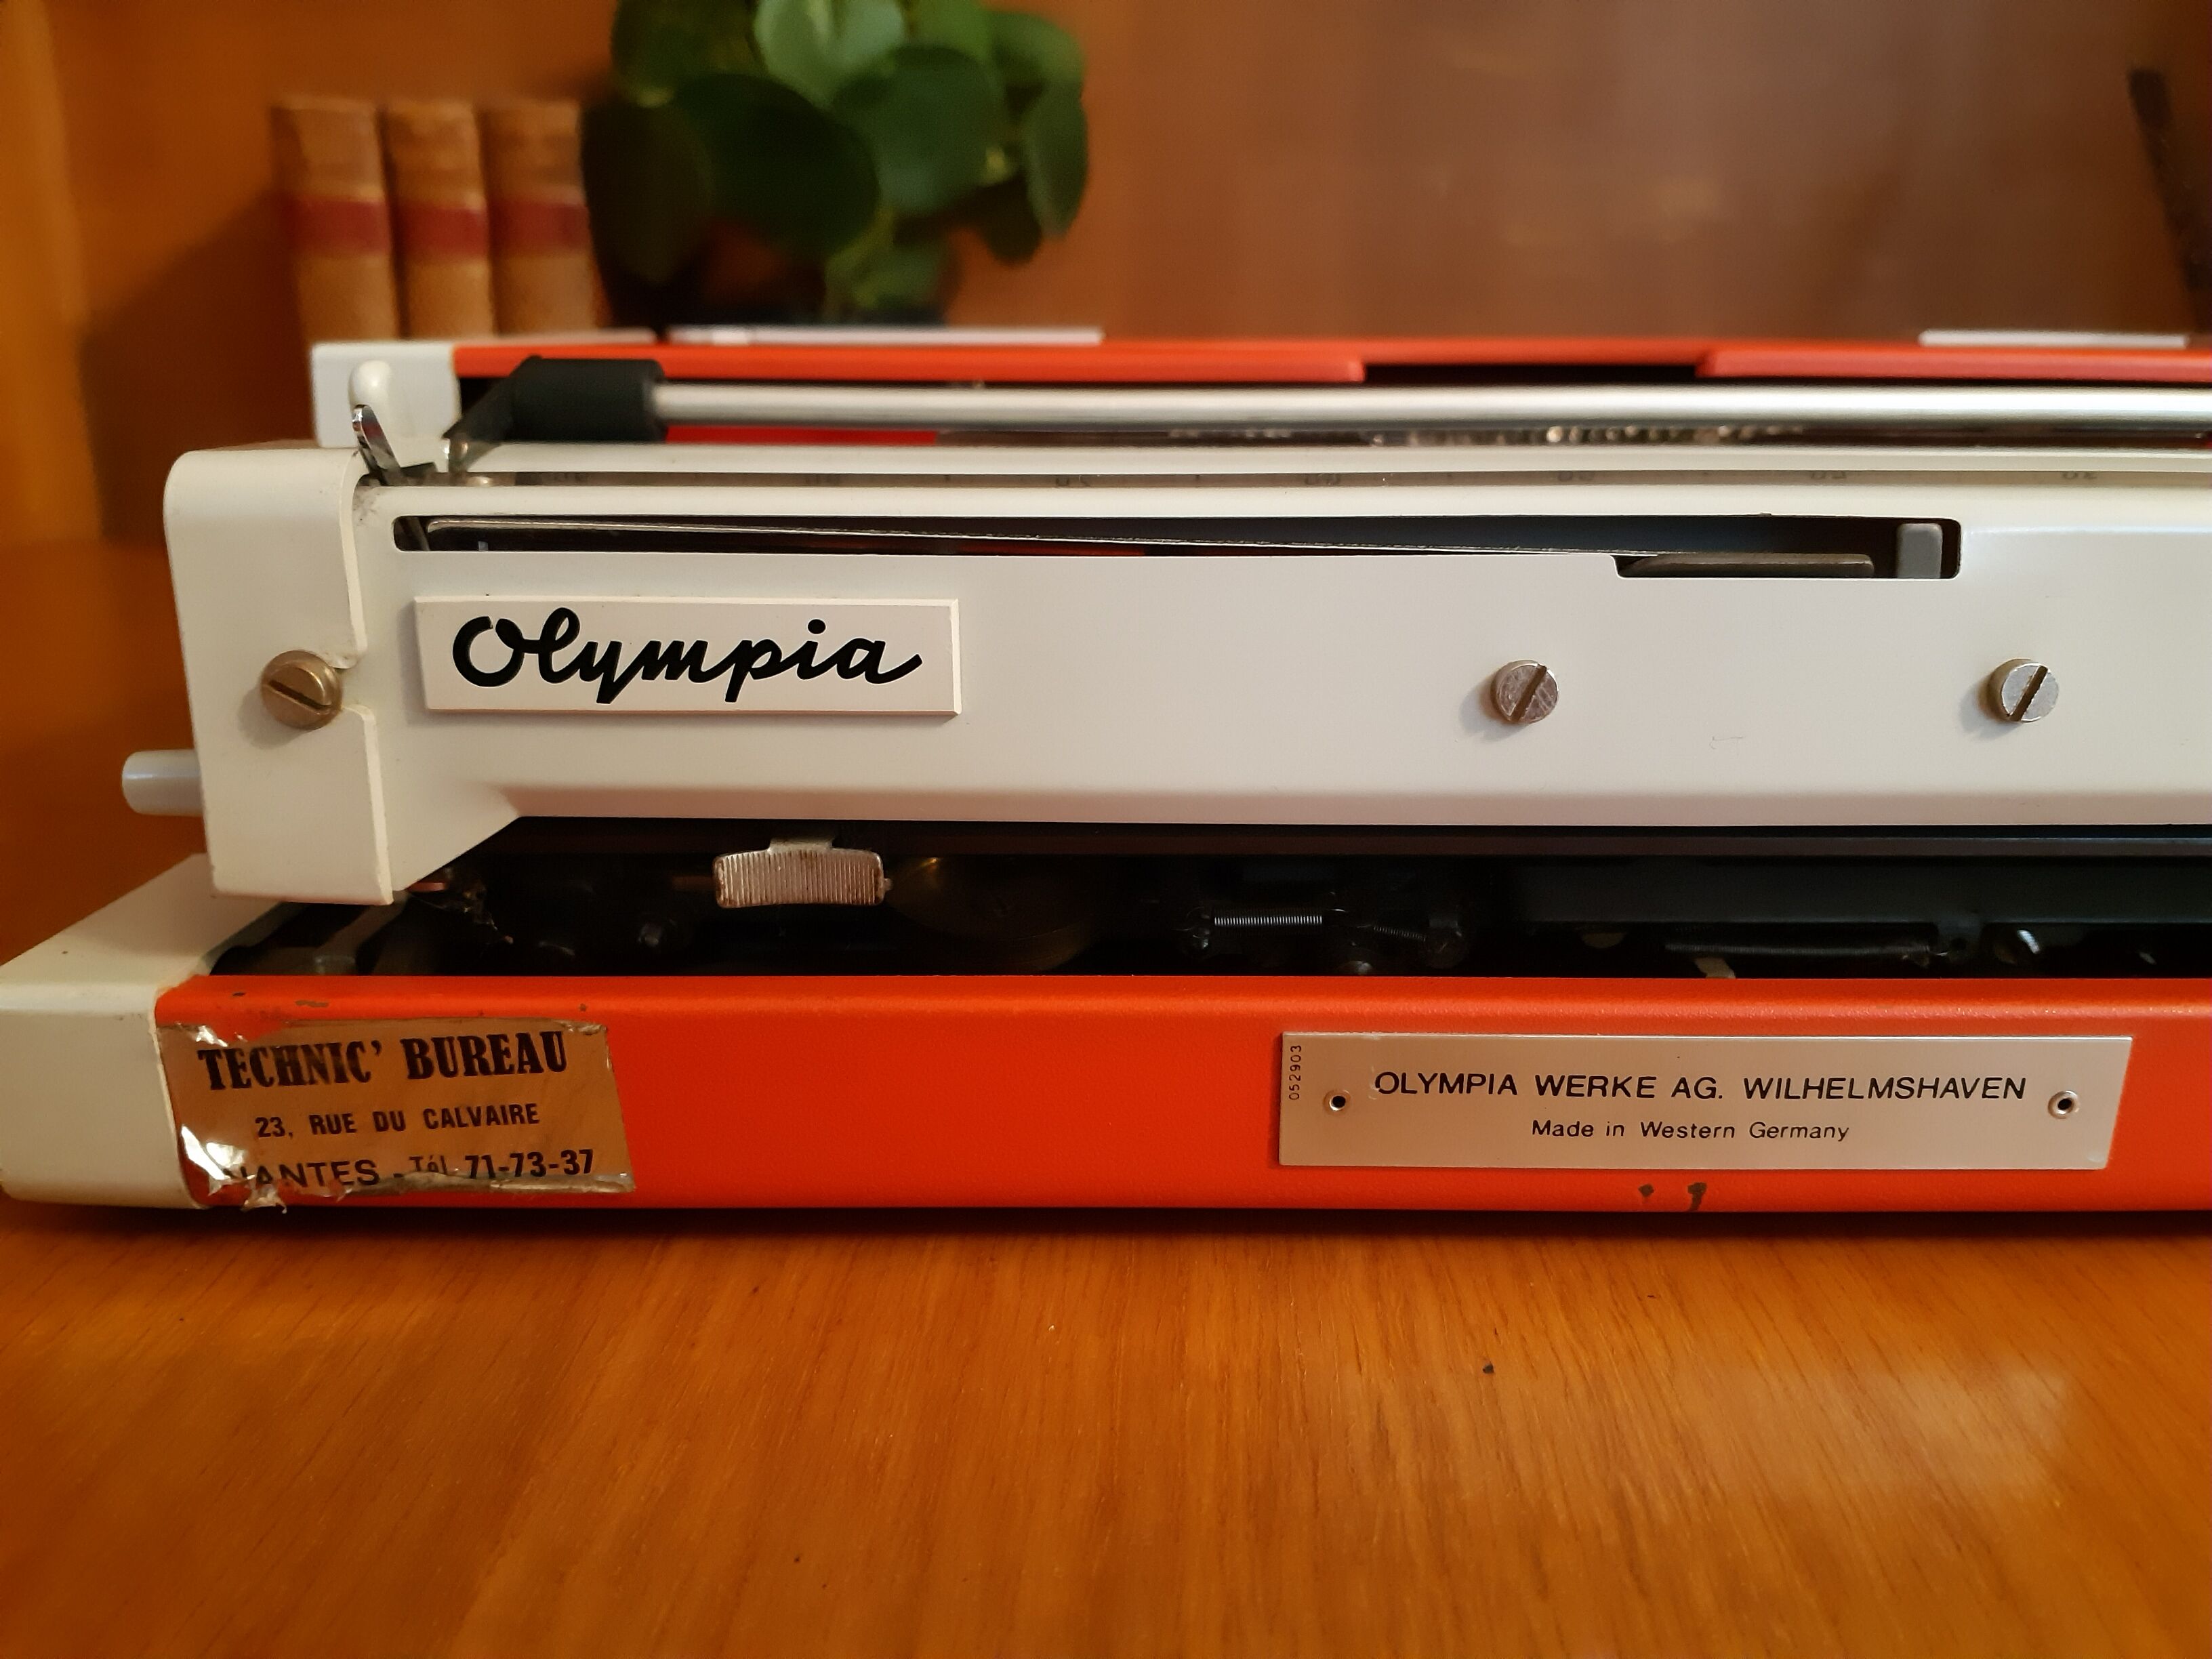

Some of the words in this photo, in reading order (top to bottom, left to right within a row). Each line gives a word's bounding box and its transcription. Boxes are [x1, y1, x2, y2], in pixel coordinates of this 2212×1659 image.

[453, 607, 922, 703] Olympia
[198, 1040, 382, 1090] TECHNIC'
[400, 1031, 567, 1080] BUREAU
[1288, 1045, 1302, 1101] 052903
[1375, 1071, 1518, 1096] OLYMPIA
[1535, 1074, 1657, 1098] WERKE
[1671, 1076, 1723, 1099] AG.
[1743, 1076, 2026, 1100] WILHELMSHAVEN
[255, 1117, 293, 1140] 23,
[309, 1113, 356, 1134] RUE
[372, 1111, 406, 1132] DU
[423, 1103, 540, 1130] CALVAIRE
[1532, 1120, 1595, 1137] Made
[1606, 1122, 1624, 1136] in
[1640, 1122, 1735, 1139] Western
[1748, 1122, 1849, 1141] Germany
[465, 1149, 593, 1179] 71-73-37
